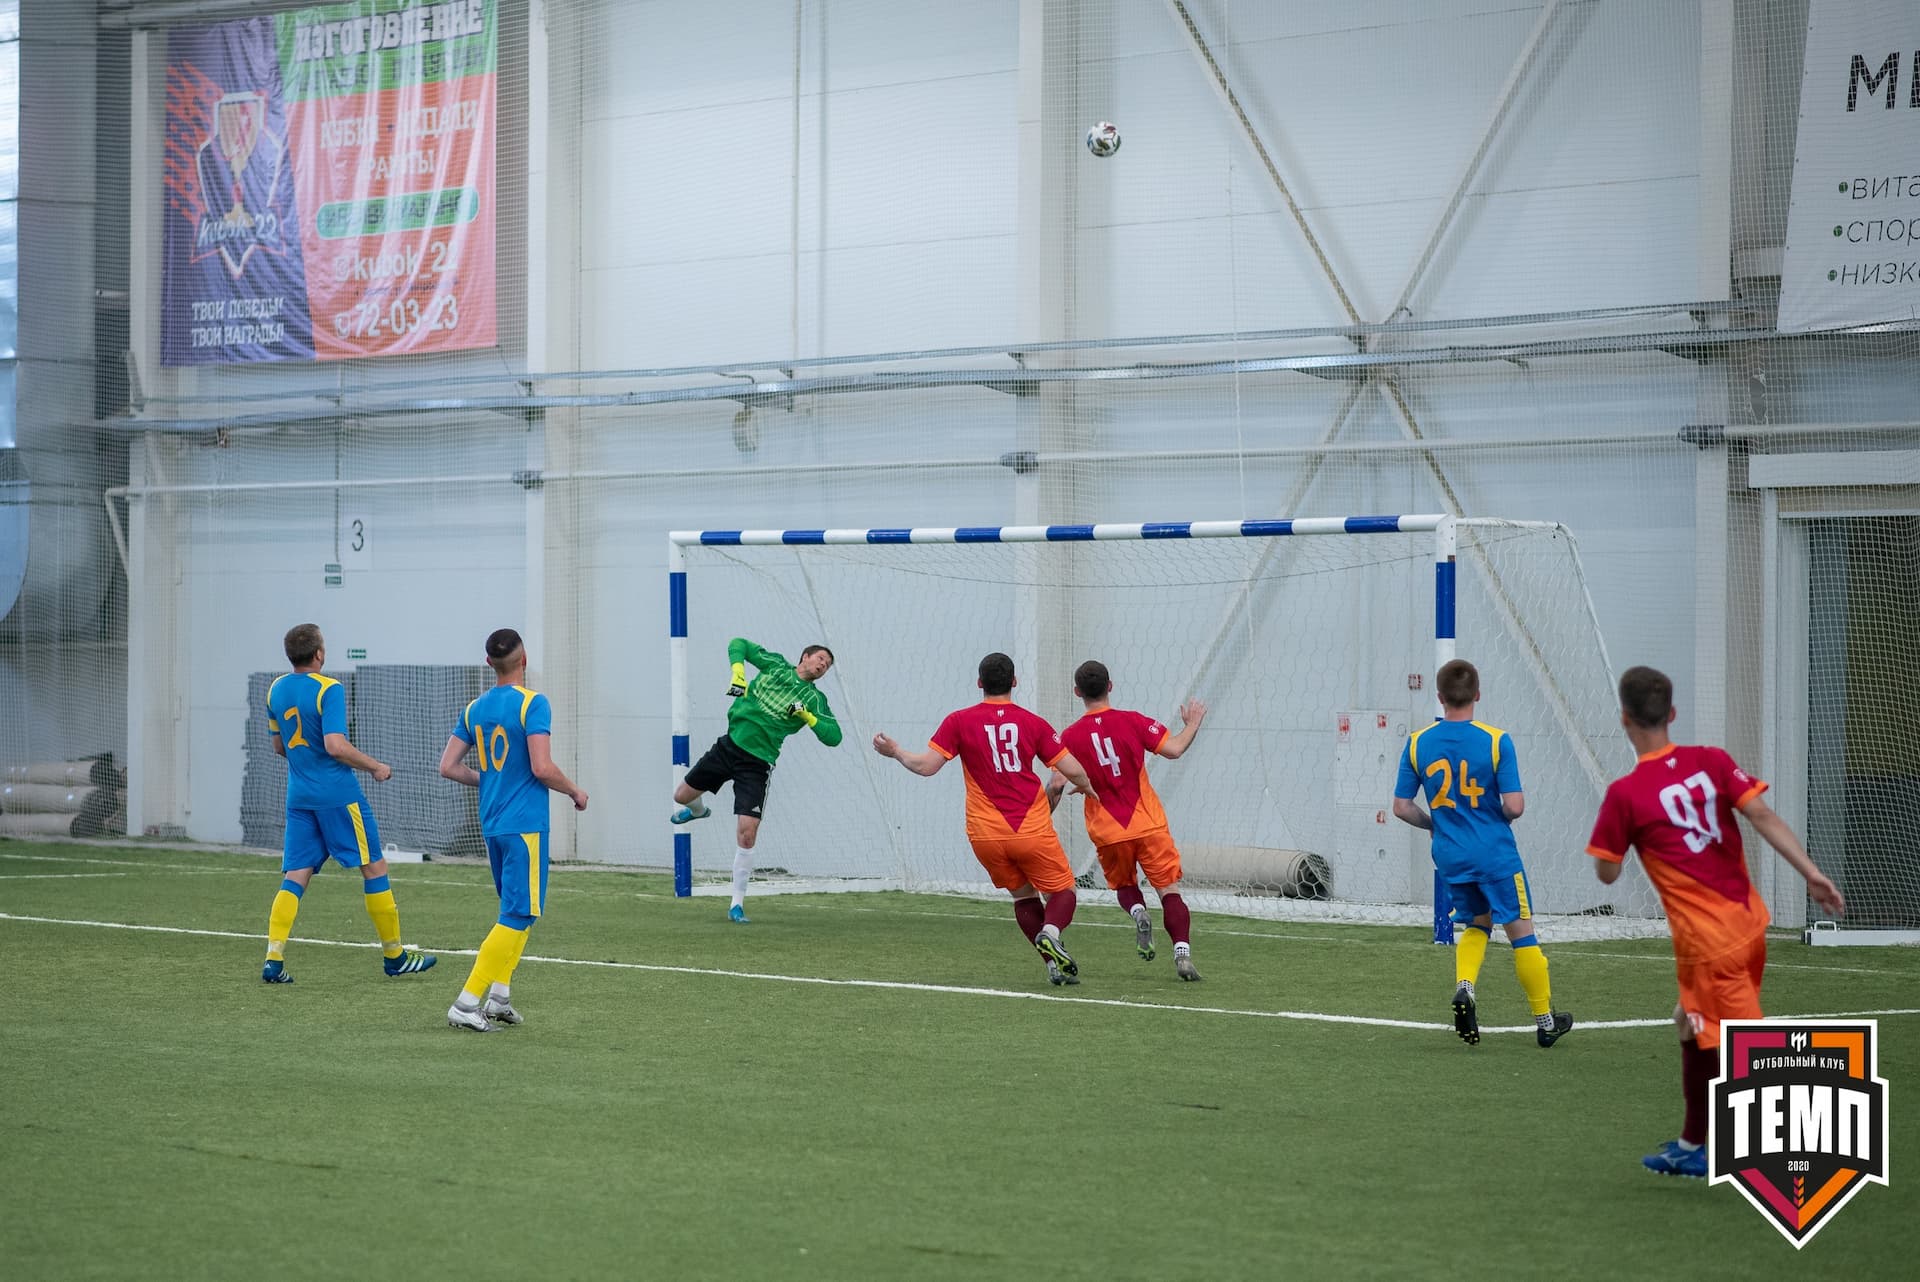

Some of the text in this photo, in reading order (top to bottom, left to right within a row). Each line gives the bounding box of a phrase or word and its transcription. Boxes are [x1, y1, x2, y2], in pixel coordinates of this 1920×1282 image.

[295, 0, 483, 63] ИЗГОТОВЛЕНИЕ
[198, 213, 280, 247] kubok_22
[1847, 218, 1920, 247] спор
[1841, 262, 1920, 286] низк
[191, 300, 226, 321] ТВОИ
[355, 294, 459, 336] 72-03-23
[191, 326, 222, 347] ТВОИ
[351, 519, 364, 552] 3
[284, 706, 310, 749] 2
[475, 724, 509, 772] 10
[984, 722, 1022, 773] 13
[1090, 732, 1121, 777] 4
[1425, 758, 1485, 809] 24
[1659, 770, 1722, 853] 97
